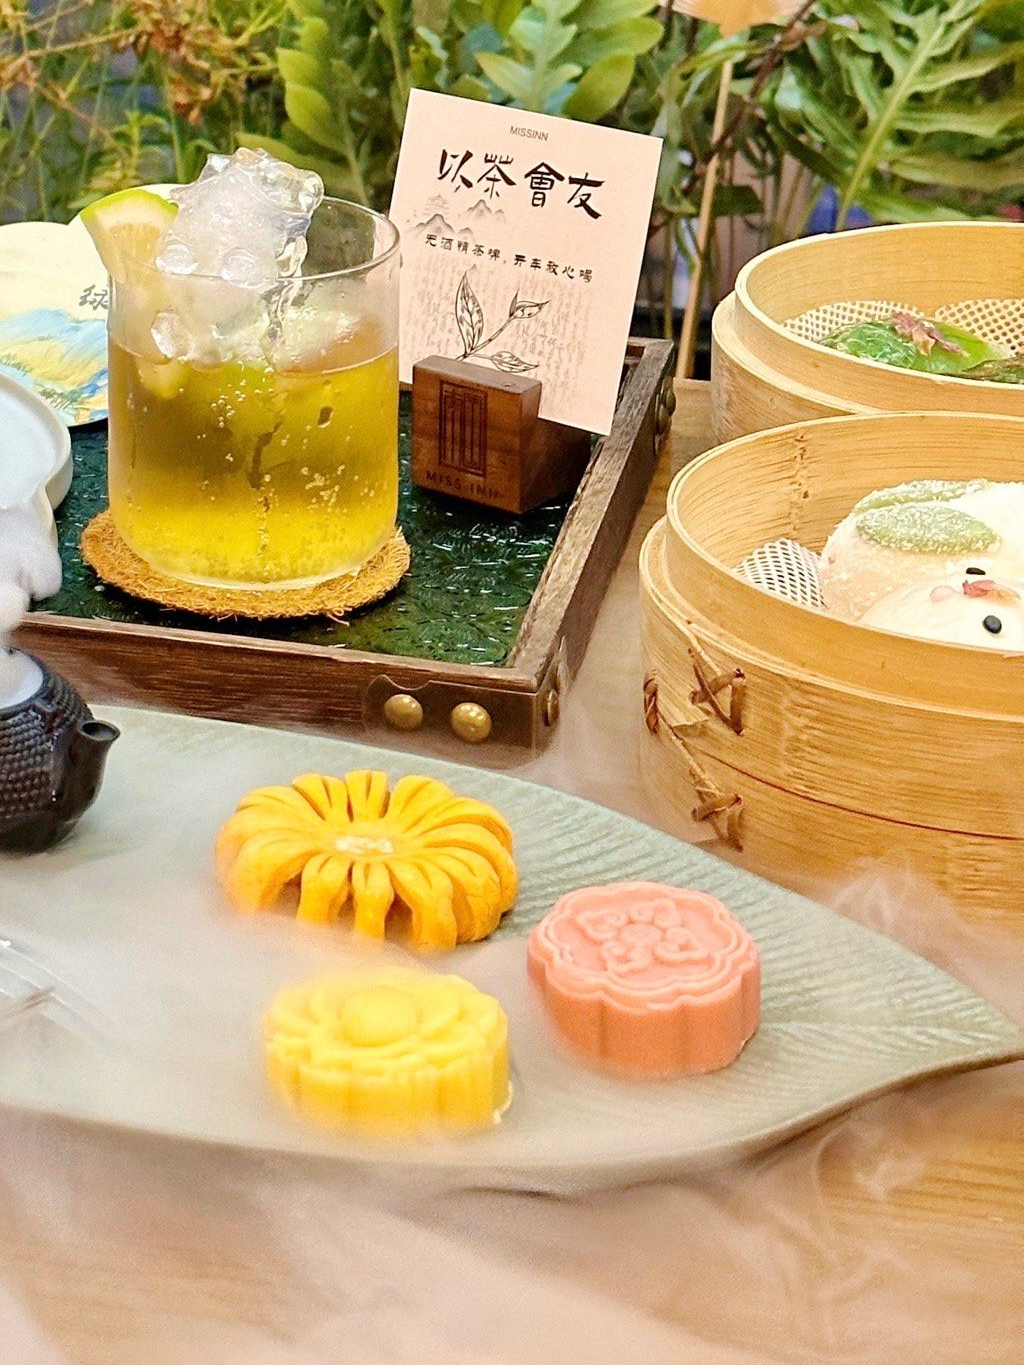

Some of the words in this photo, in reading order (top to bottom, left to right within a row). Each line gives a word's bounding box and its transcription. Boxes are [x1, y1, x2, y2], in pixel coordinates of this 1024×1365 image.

[509, 125, 549, 142] MISSINN
[437, 149, 606, 219] 以茶會友
[426, 470, 463, 490] MISS
